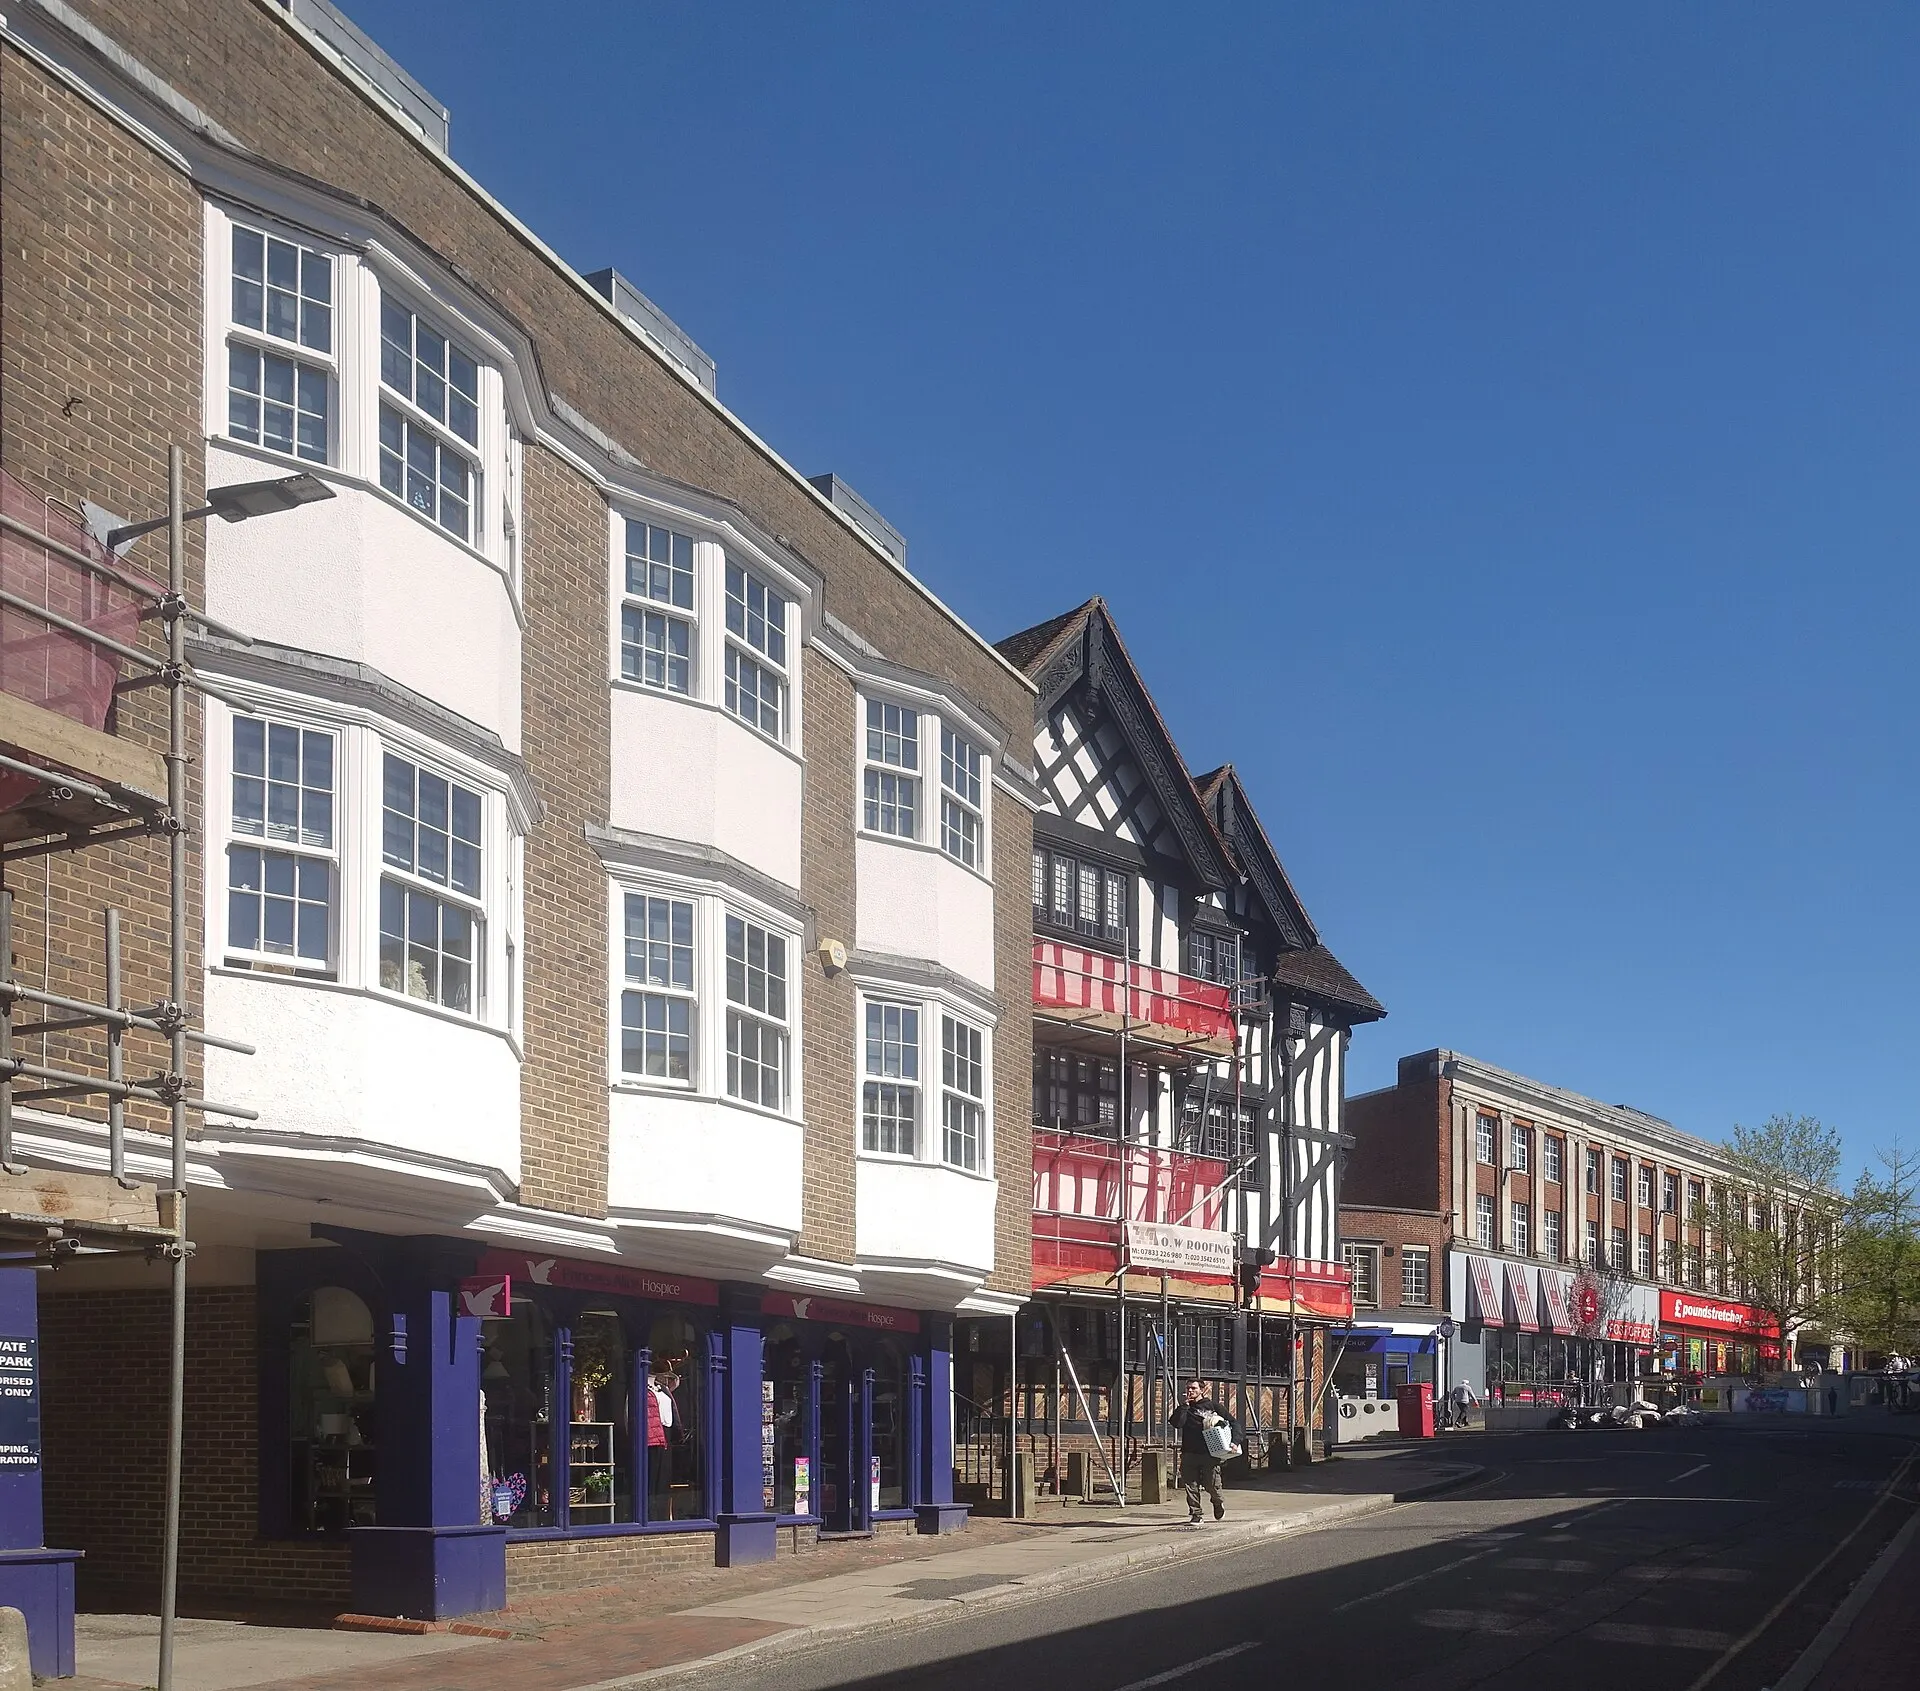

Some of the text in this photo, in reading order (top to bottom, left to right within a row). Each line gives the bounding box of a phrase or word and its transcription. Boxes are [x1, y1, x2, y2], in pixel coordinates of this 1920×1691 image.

[1140, 1248, 1159, 1257] 07833
[1187, 1239, 1230, 1255] ROOFING
[642, 1278, 680, 1297] Hospice
[868, 1311, 894, 1326] Hospice
[1682, 1304, 1744, 1324] poundstretcher
[1629, 1324, 1653, 1340] OFFICE
[0, 1341, 27, 1352] ATE
[4, 1388, 33, 1396] ONLY
